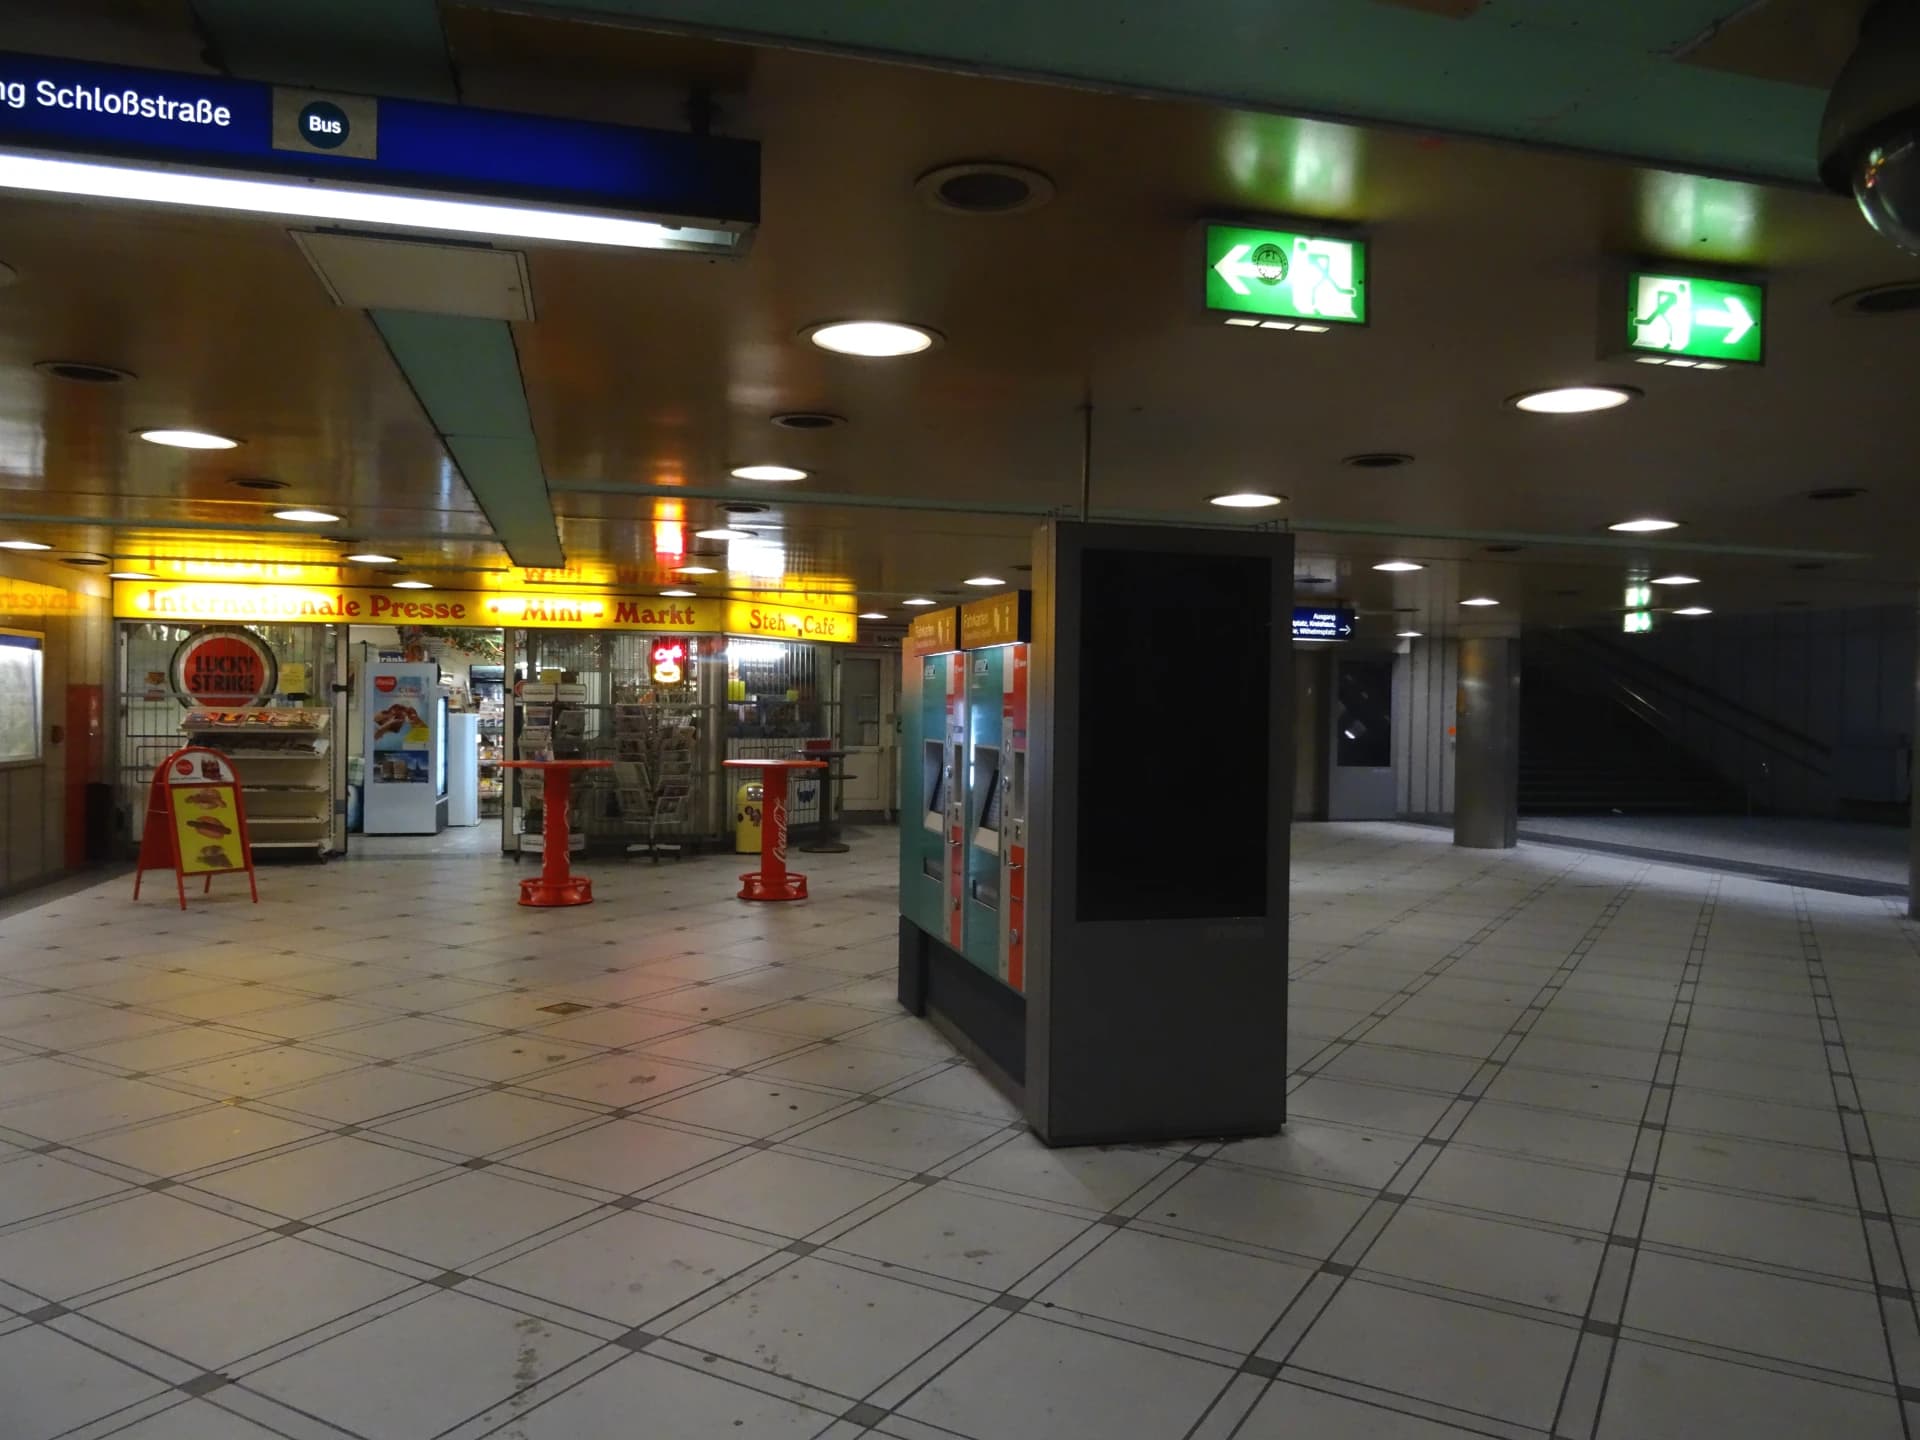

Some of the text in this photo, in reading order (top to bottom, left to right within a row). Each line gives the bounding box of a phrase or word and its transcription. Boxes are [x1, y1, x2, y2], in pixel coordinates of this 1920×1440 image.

[36, 81, 231, 126] Schloßstraße
[309, 114, 342, 135] Bus
[147, 590, 466, 619] Internationale Presse
[522, 599, 583, 622] Mini
[615, 602, 696, 624] Markt
[750, 609, 786, 628] Steh
[803, 616, 836, 635] Café
[195, 656, 254, 673] LUCKY
[191, 674, 257, 694] STRIKE
